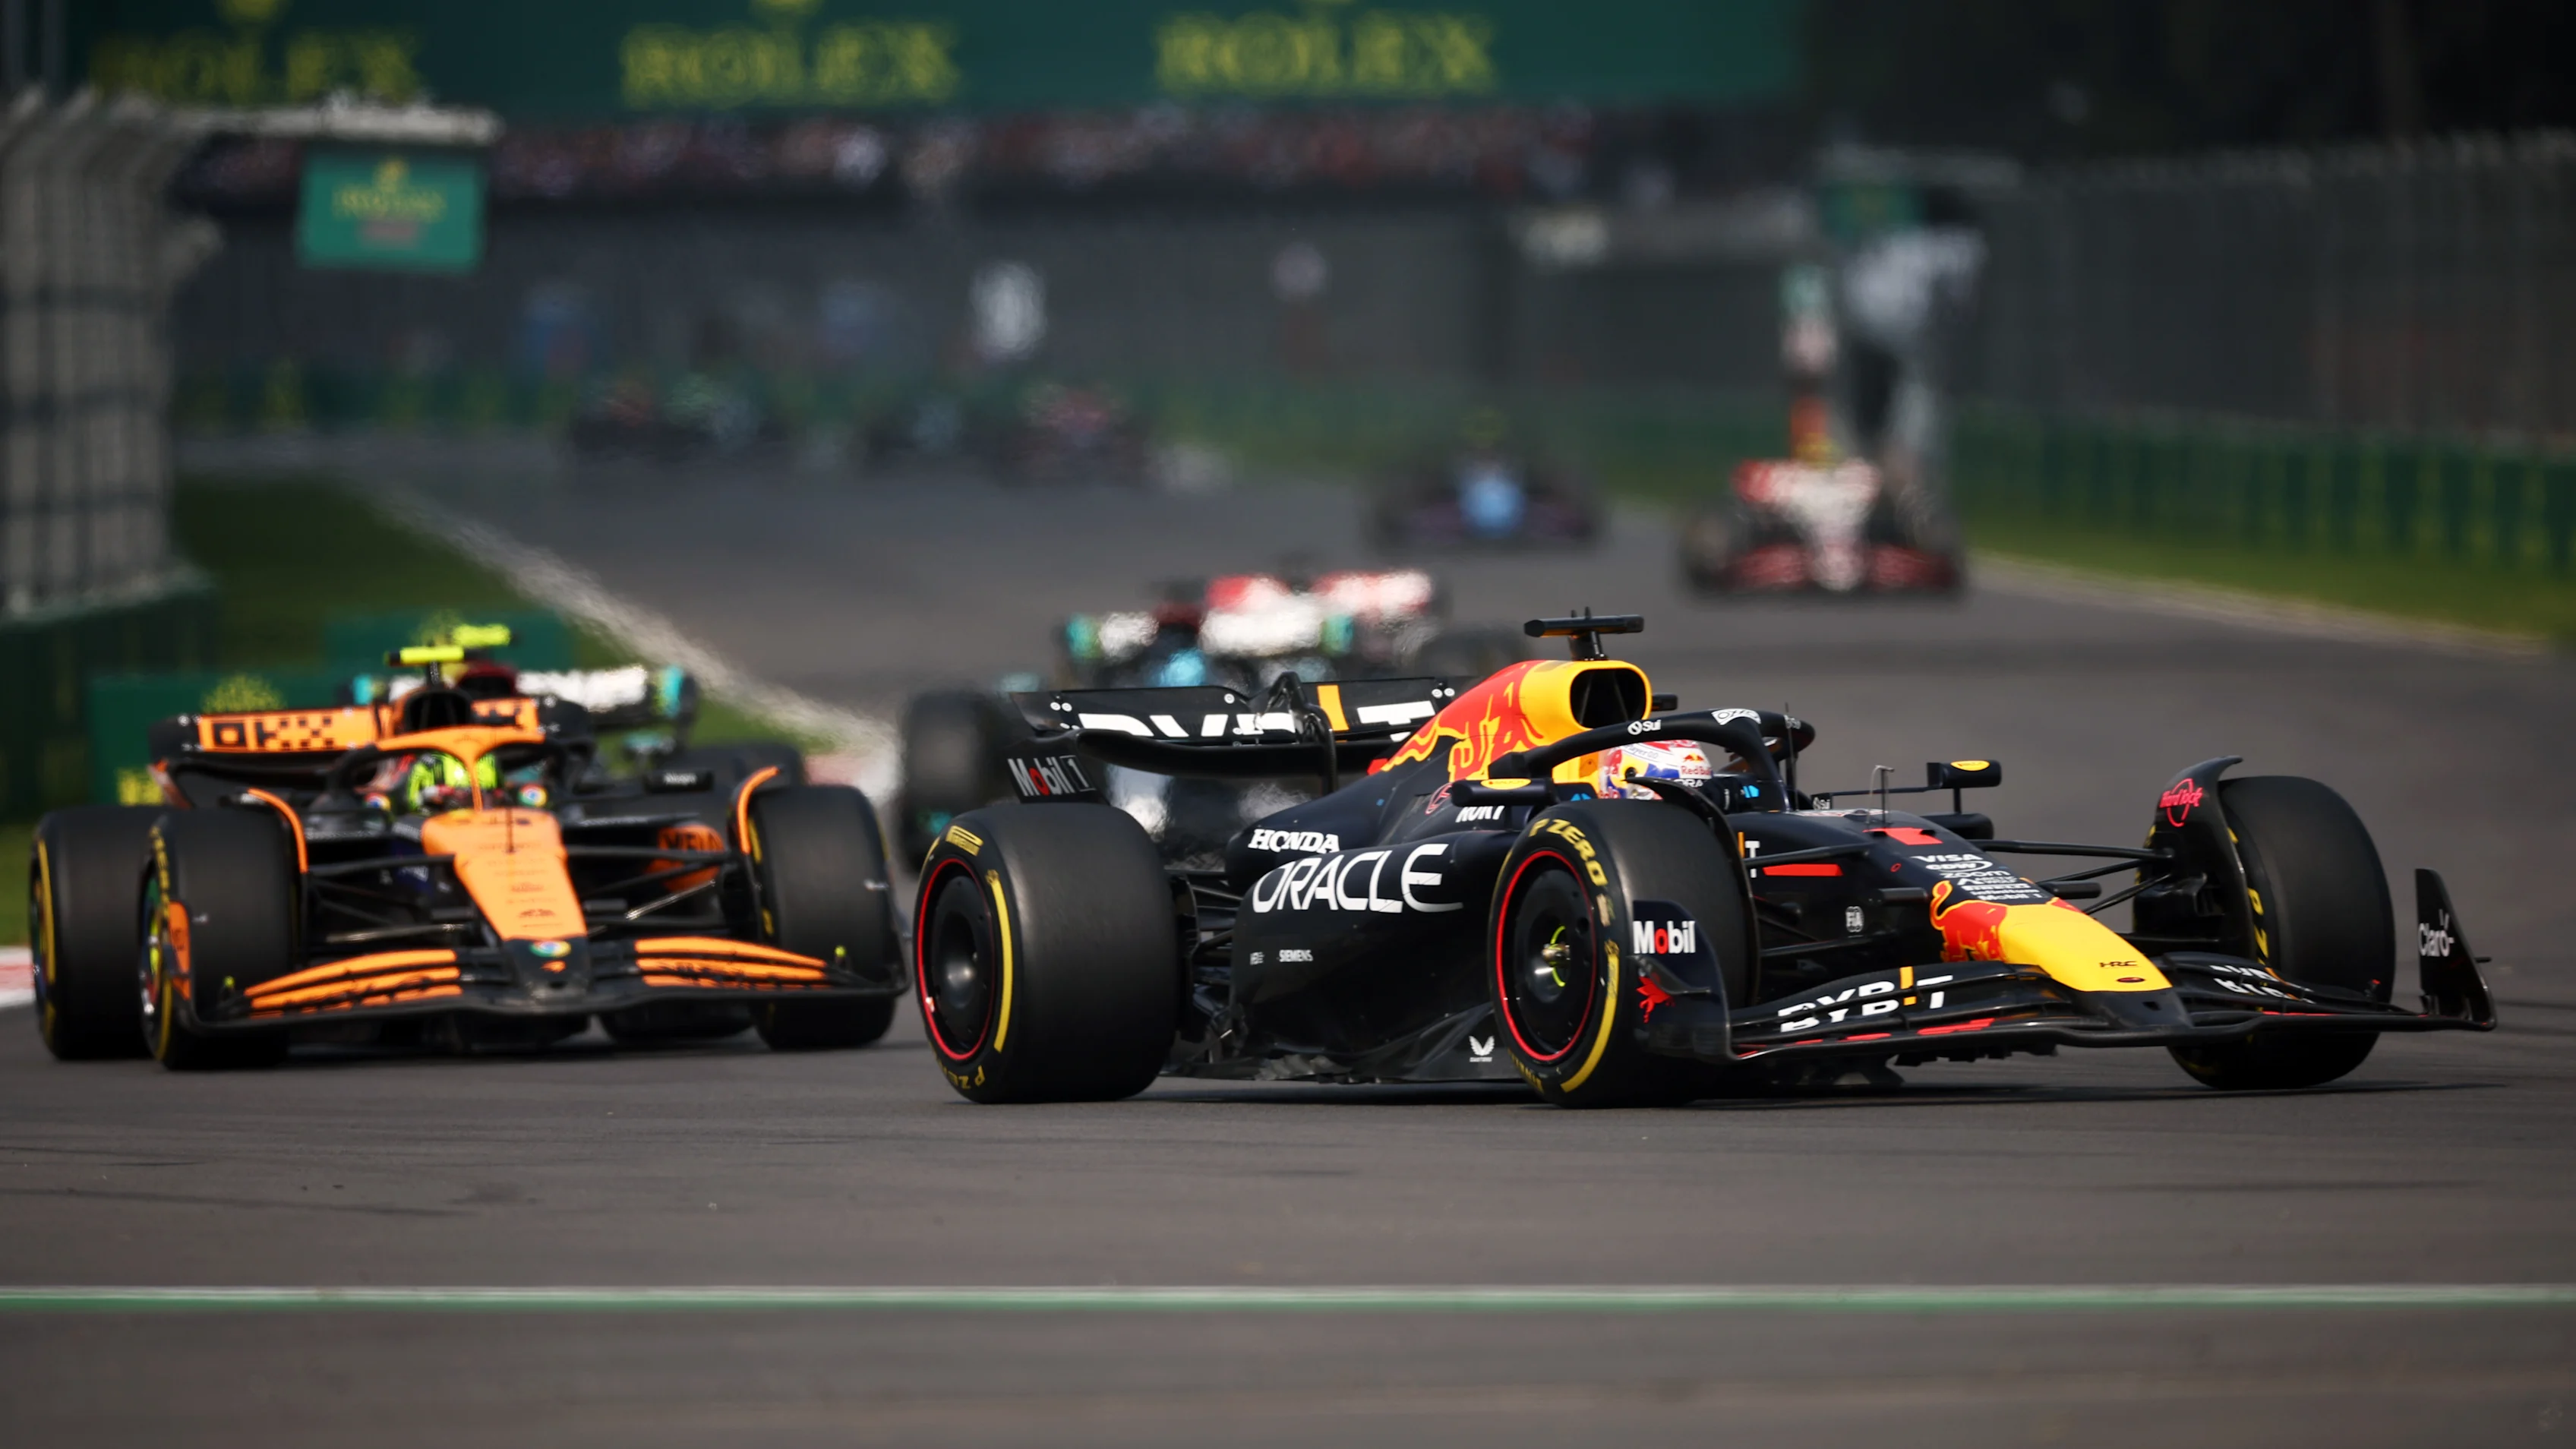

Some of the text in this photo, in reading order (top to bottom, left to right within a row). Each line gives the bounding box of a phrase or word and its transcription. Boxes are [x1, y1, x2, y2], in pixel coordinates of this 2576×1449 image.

[621, 24, 955, 104] ROLEX
[1159, 12, 1493, 94] ROLEX
[1643, 720, 1662, 731] Sui
[1007, 756, 1090, 797] Mobil 1
[1681, 765, 1700, 775] Red
[1248, 829, 1340, 854] HONDA
[1546, 818, 1609, 887] ZERO
[1909, 854, 1984, 863] VISA
[1925, 862, 1977, 871] CDW
[1252, 843, 1463, 914] ORACLE
[1940, 870, 2012, 879] zoom
[1633, 920, 1696, 955] Mobil
[1279, 949, 1314, 962] SIEMENS
